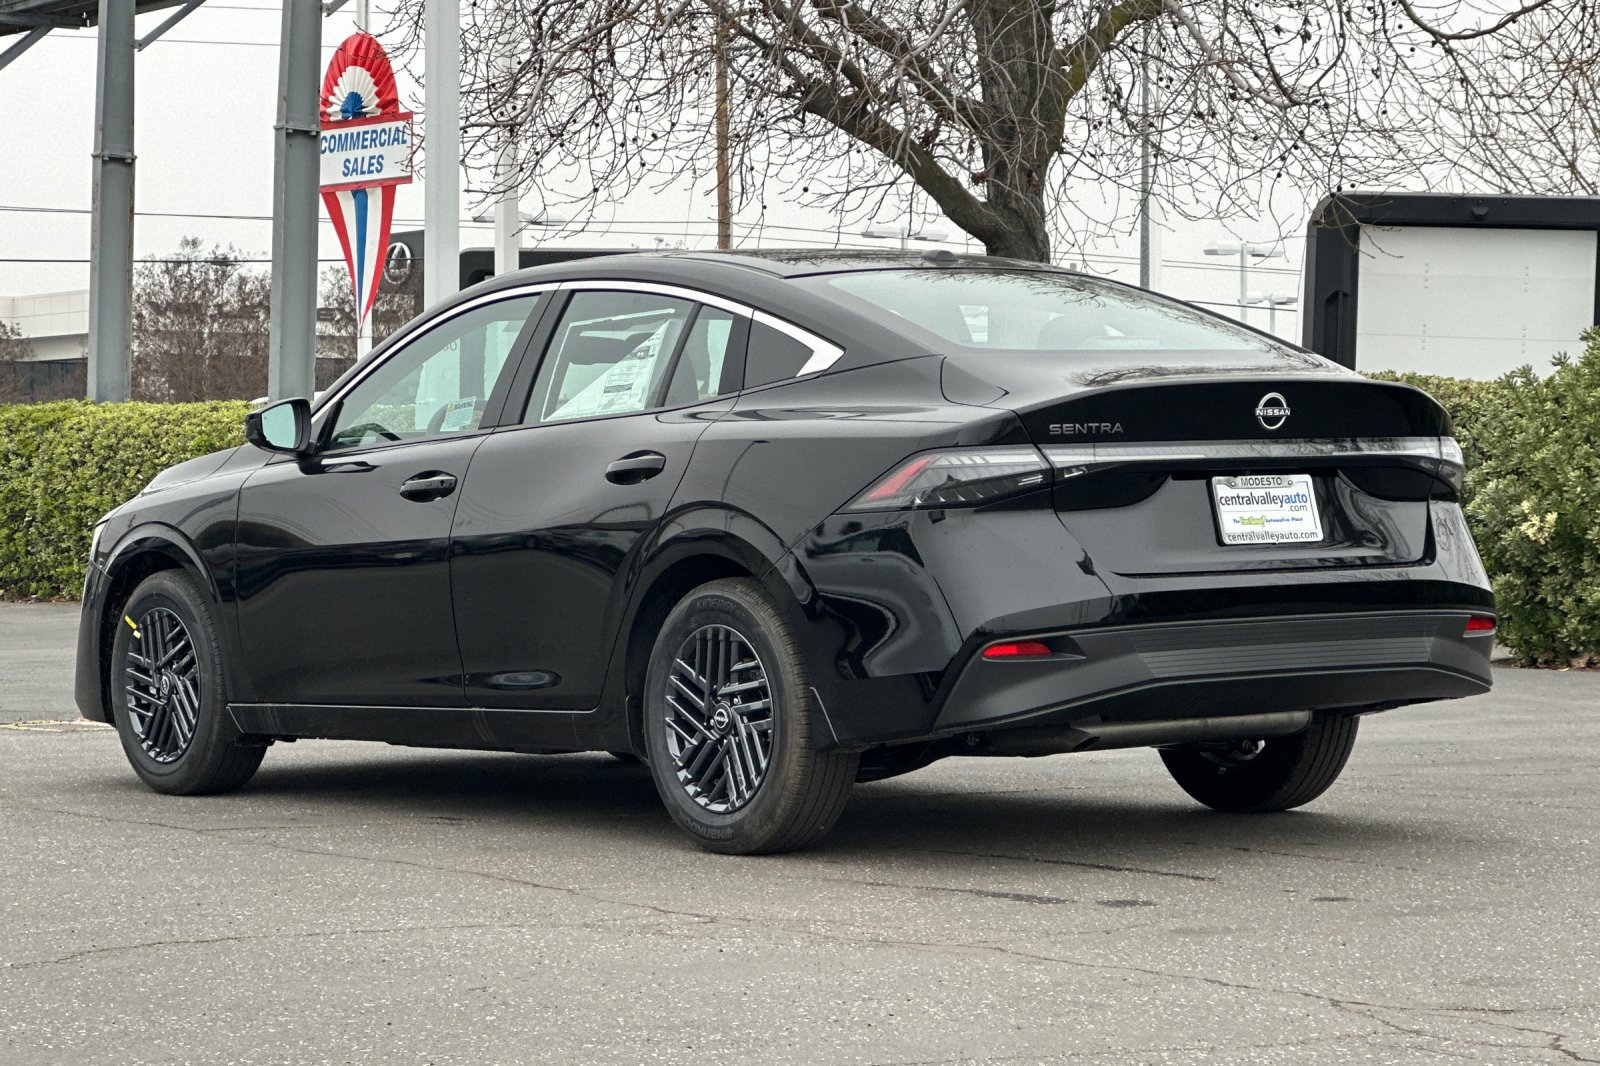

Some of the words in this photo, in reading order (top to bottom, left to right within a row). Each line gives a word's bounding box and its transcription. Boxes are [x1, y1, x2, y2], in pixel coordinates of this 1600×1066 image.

[320, 125, 408, 155] COMMERCIAL
[342, 154, 384, 177] SALES
[1256, 408, 1290, 416] NISSAN
[1049, 422, 1124, 435] SENTRA
[1241, 477, 1283, 487] MODESTO
[1219, 491, 1308, 508] centralvalleyauto
[1287, 503, 1308, 512] .com
[1228, 530, 1318, 543] centralvalleyauto.com
